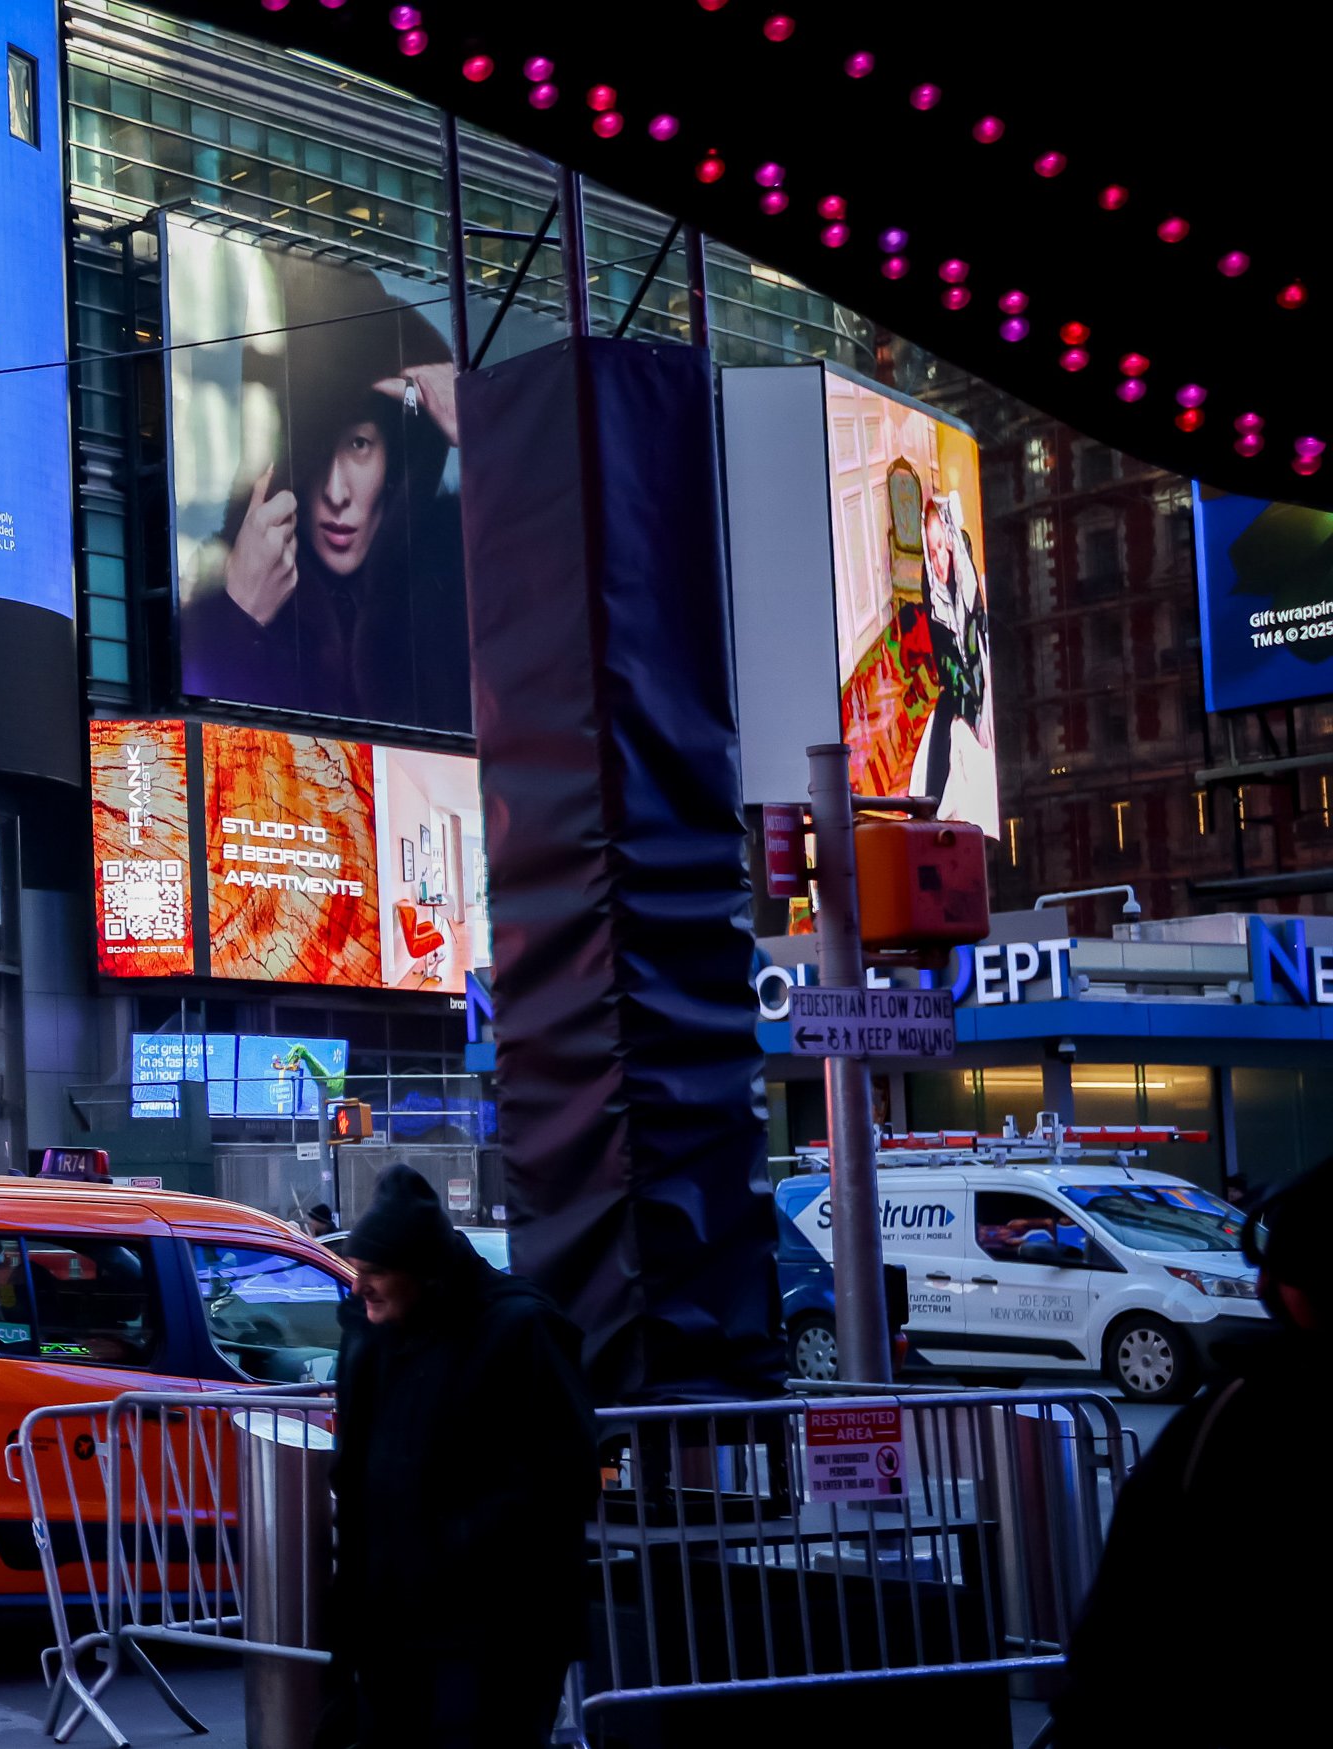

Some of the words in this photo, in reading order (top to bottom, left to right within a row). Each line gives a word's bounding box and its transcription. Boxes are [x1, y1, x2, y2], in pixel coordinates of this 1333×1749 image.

[1250, 609, 1276, 628] Gift
[1251, 631, 1273, 648] TM
[1274, 630, 1284, 645] &
[1300, 620, 1333, 640] 2025
[142, 763, 153, 803] WEST
[126, 744, 143, 845] FRANK
[222, 817, 296, 840] STUDIO
[299, 825, 327, 843] TO
[223, 844, 239, 861] 2
[242, 847, 341, 869] BEDROOM
[224, 869, 364, 897] APARTMENTS
[107, 945, 135, 954] SCAN
[137, 945, 158, 954] FOR
[160, 945, 185, 954] SITE
[792, 994, 867, 1018] PEDESTRIAN
[871, 997, 907, 1019] FLOW
[914, 997, 952, 1019] ZONE
[857, 1026, 892, 1050] KEEP
[897, 1026, 952, 1051] MOVING
[140, 1043, 160, 1055] Get
[152, 1058, 163, 1068] as
[186, 1058, 199, 1068] as
[140, 1071, 153, 1081] an
[155, 1069, 181, 1081] hour
[57, 1154, 86, 1173] 1R74
[816, 1199, 945, 1230] Strum
[909, 1293, 951, 1303] rum.com
[990, 1308, 1010, 1320] NEW
[1039, 1309, 1051, 1321] NY
[811, 1411, 895, 1427] RESTRICTED
[836, 1427, 873, 1440] AREA
